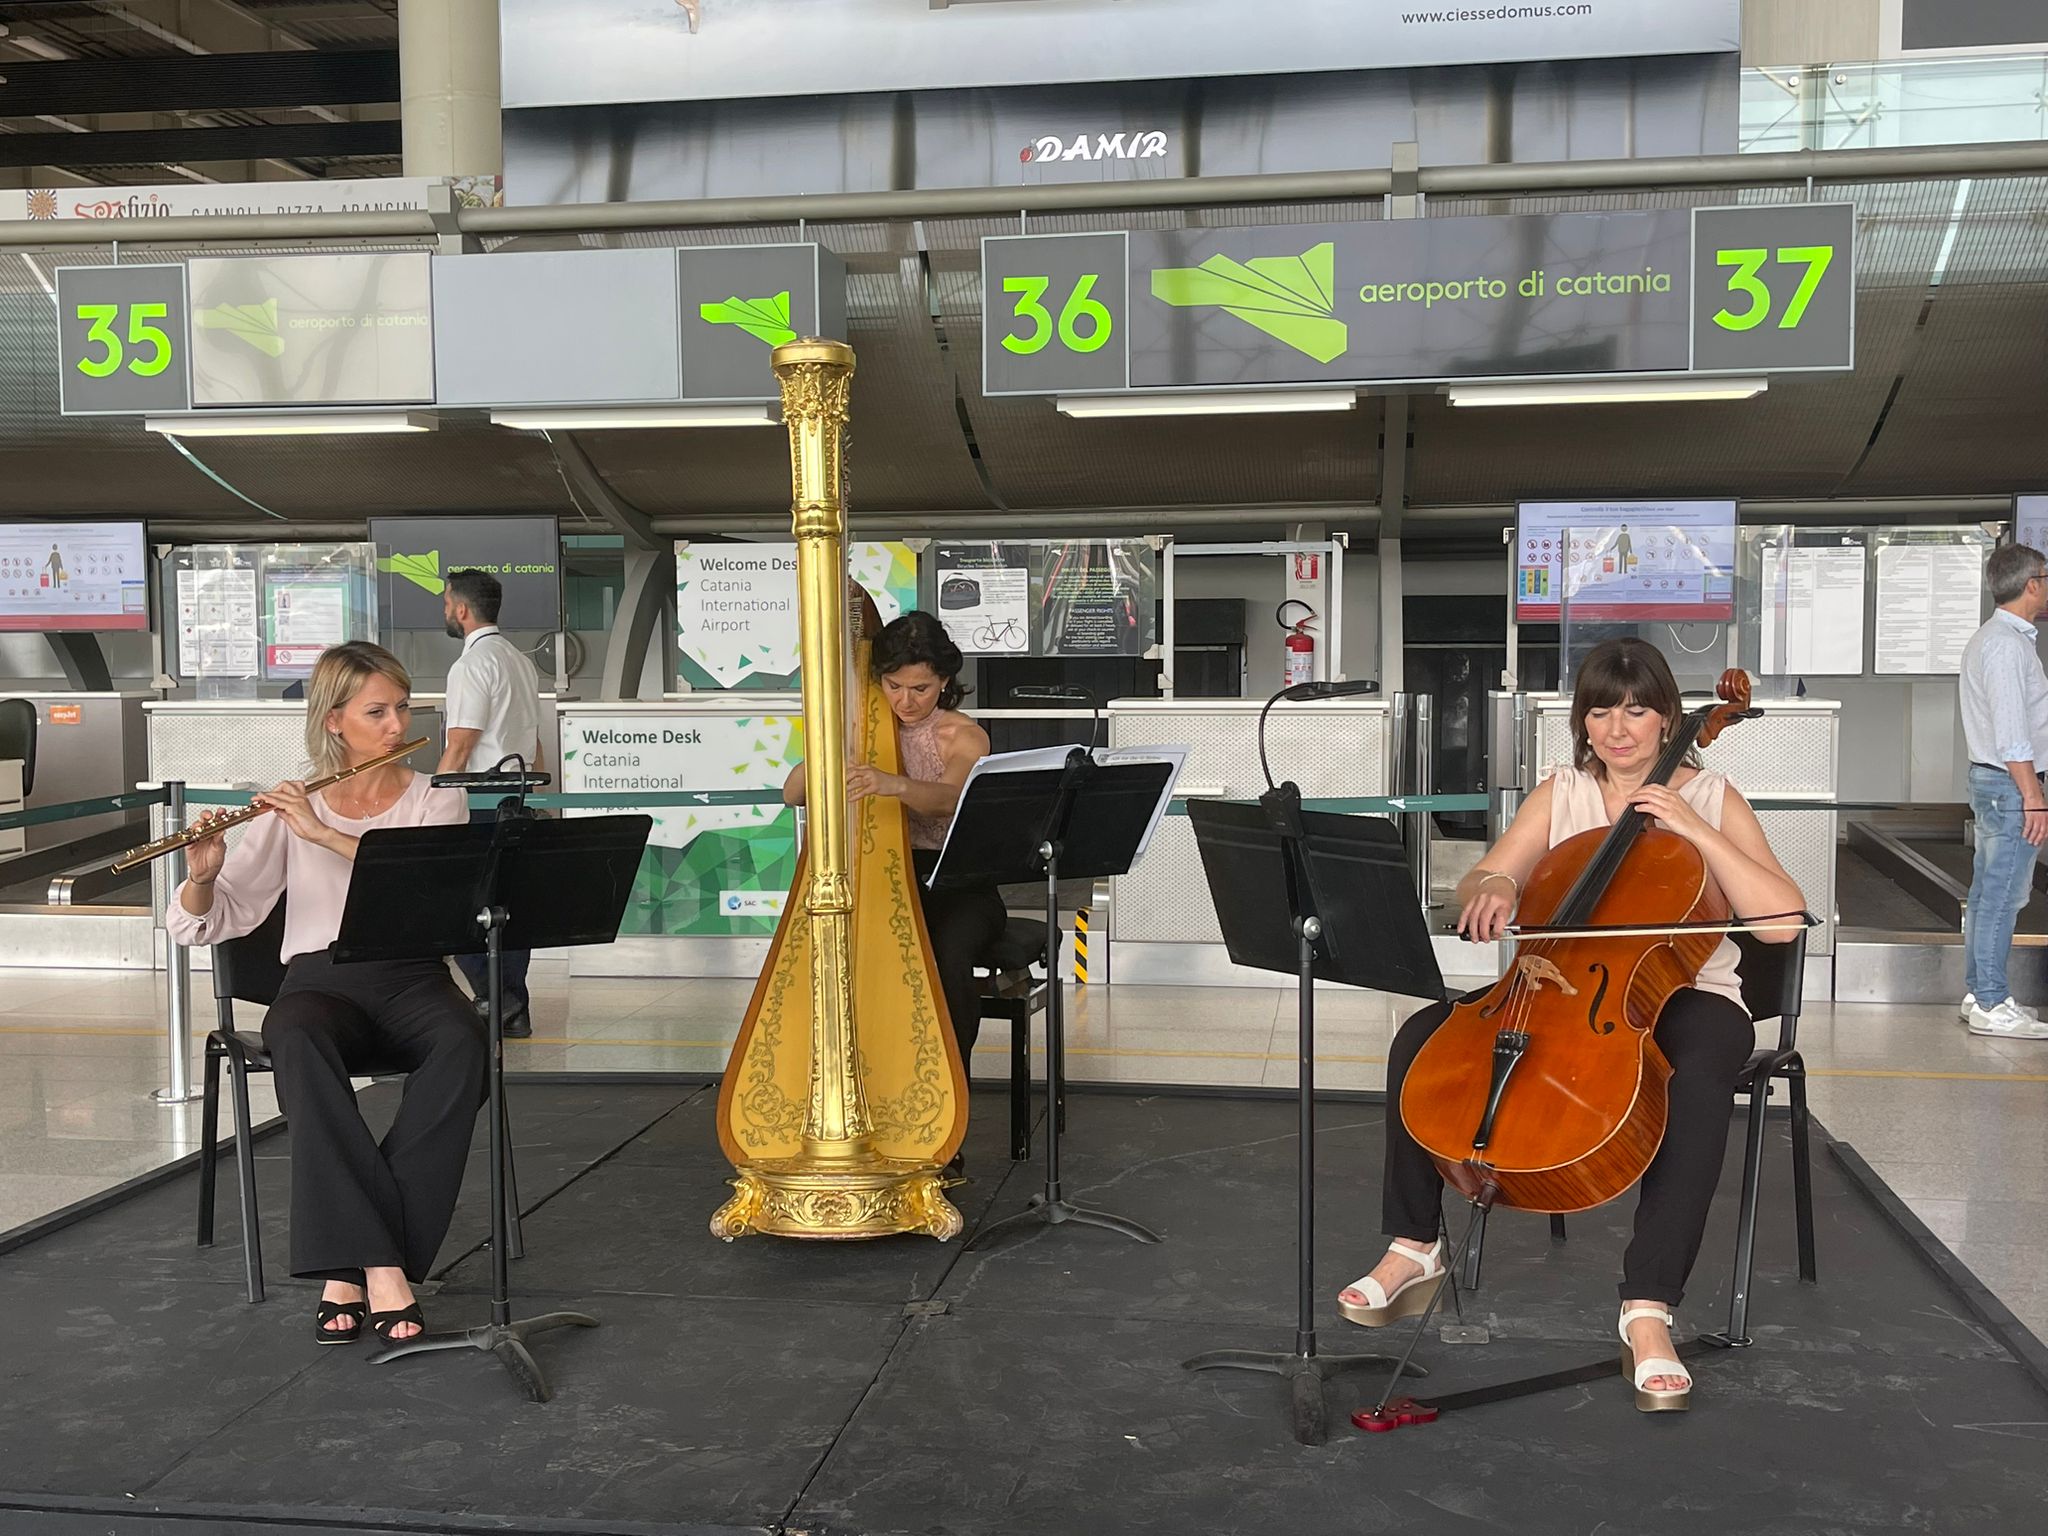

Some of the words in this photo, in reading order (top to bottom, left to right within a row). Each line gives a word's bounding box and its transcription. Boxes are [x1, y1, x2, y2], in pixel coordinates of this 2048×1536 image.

[1402, 4, 1592, 24] www.ciessedomus.com
[1035, 131, 1168, 162] DAMIR
[1359, 276, 1506, 309] aeroporto
[1518, 270, 1544, 297] di
[1556, 266, 1671, 296] catania
[1712, 245, 1833, 331] 37
[1001, 274, 1112, 354] 36
[289, 316, 355, 332] aeroporto
[360, 313, 373, 327] di
[377, 313, 428, 326] catania
[77, 303, 172, 378] 35
[502, 563, 511, 573] di
[515, 563, 554, 573] catania
[700, 557, 767, 571] Welcome
[772, 558, 797, 571] Des
[701, 578, 752, 592] Catania
[701, 597, 790, 612] International
[701, 618, 750, 634] Airport
[582, 729, 657, 744] Welcome
[663, 729, 702, 744] Desk
[583, 752, 640, 767] Catania
[584, 773, 683, 789] International
